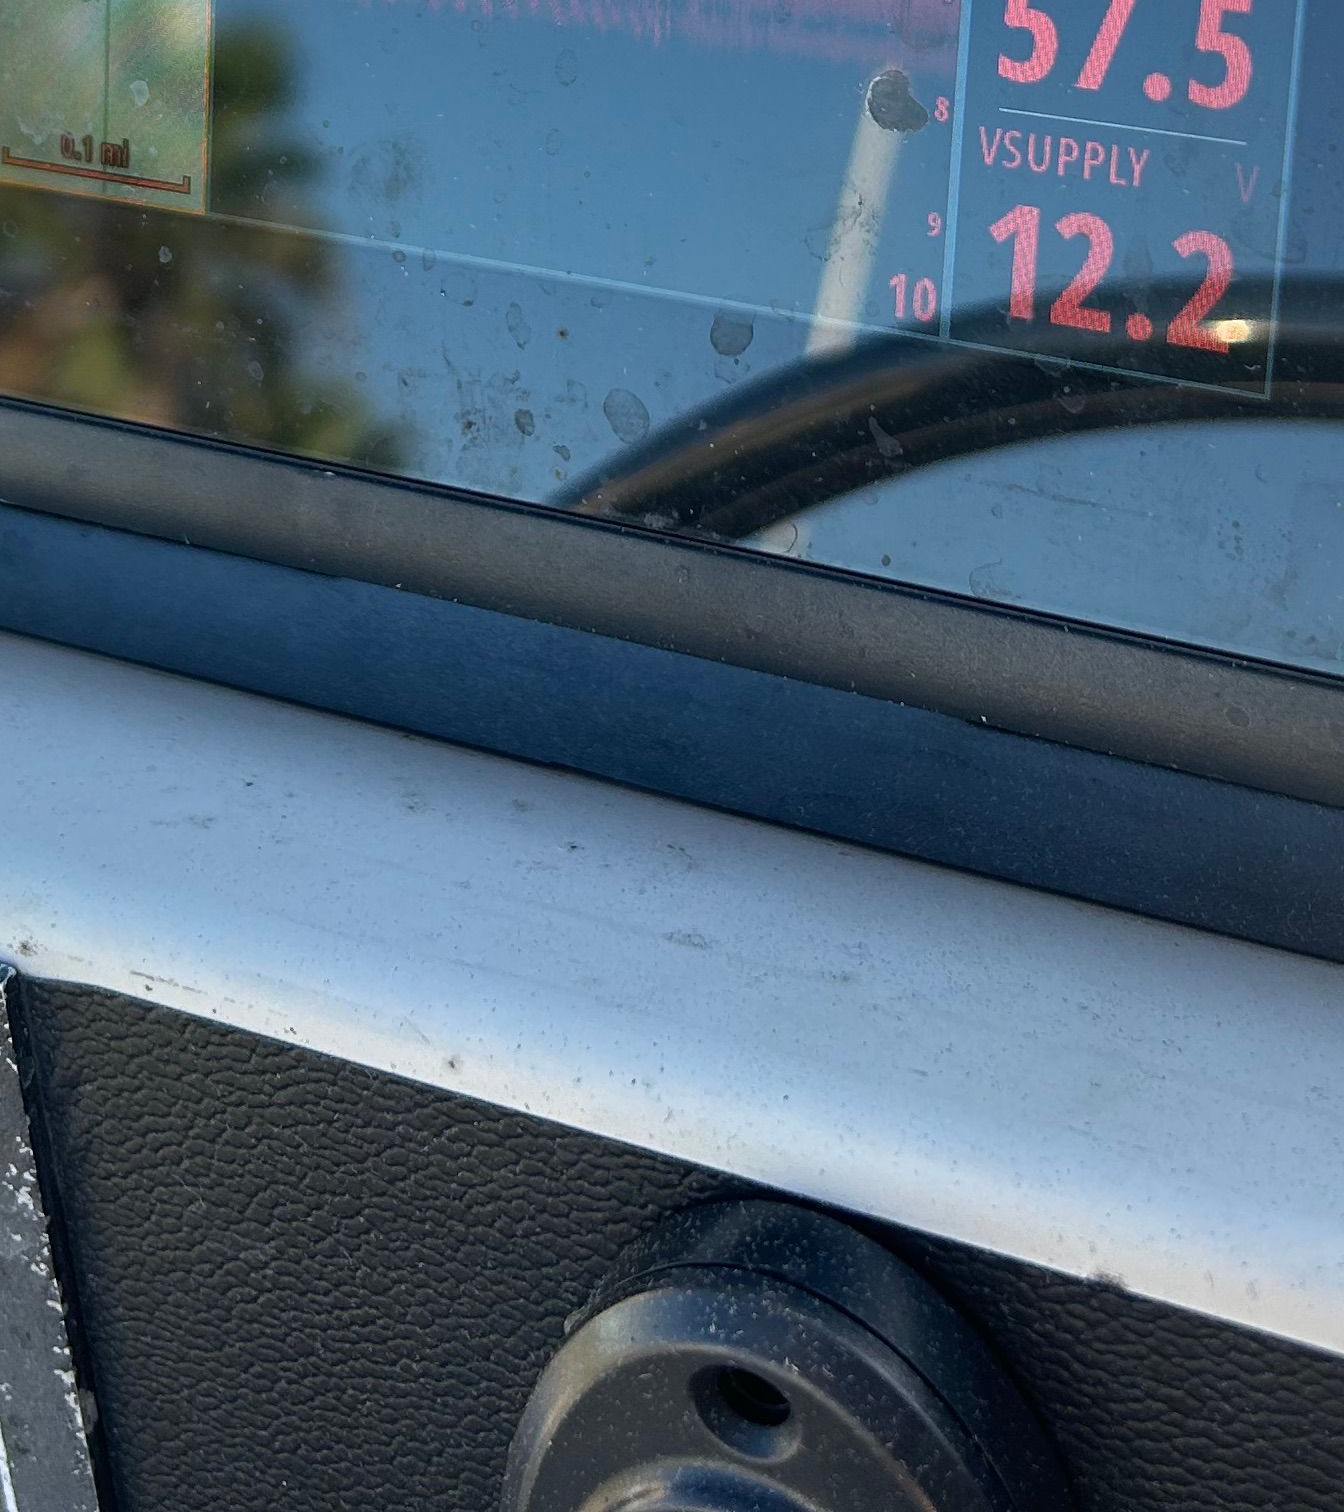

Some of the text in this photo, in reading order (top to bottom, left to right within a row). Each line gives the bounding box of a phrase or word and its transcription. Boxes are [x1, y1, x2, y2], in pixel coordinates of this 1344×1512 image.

[934, 95, 950, 123] 8
[979, 125, 1150, 188] VSUPPLY
[927, 211, 942, 239] 9
[888, 272, 937, 323] 10
[988, 204, 1235, 355] 12.2
